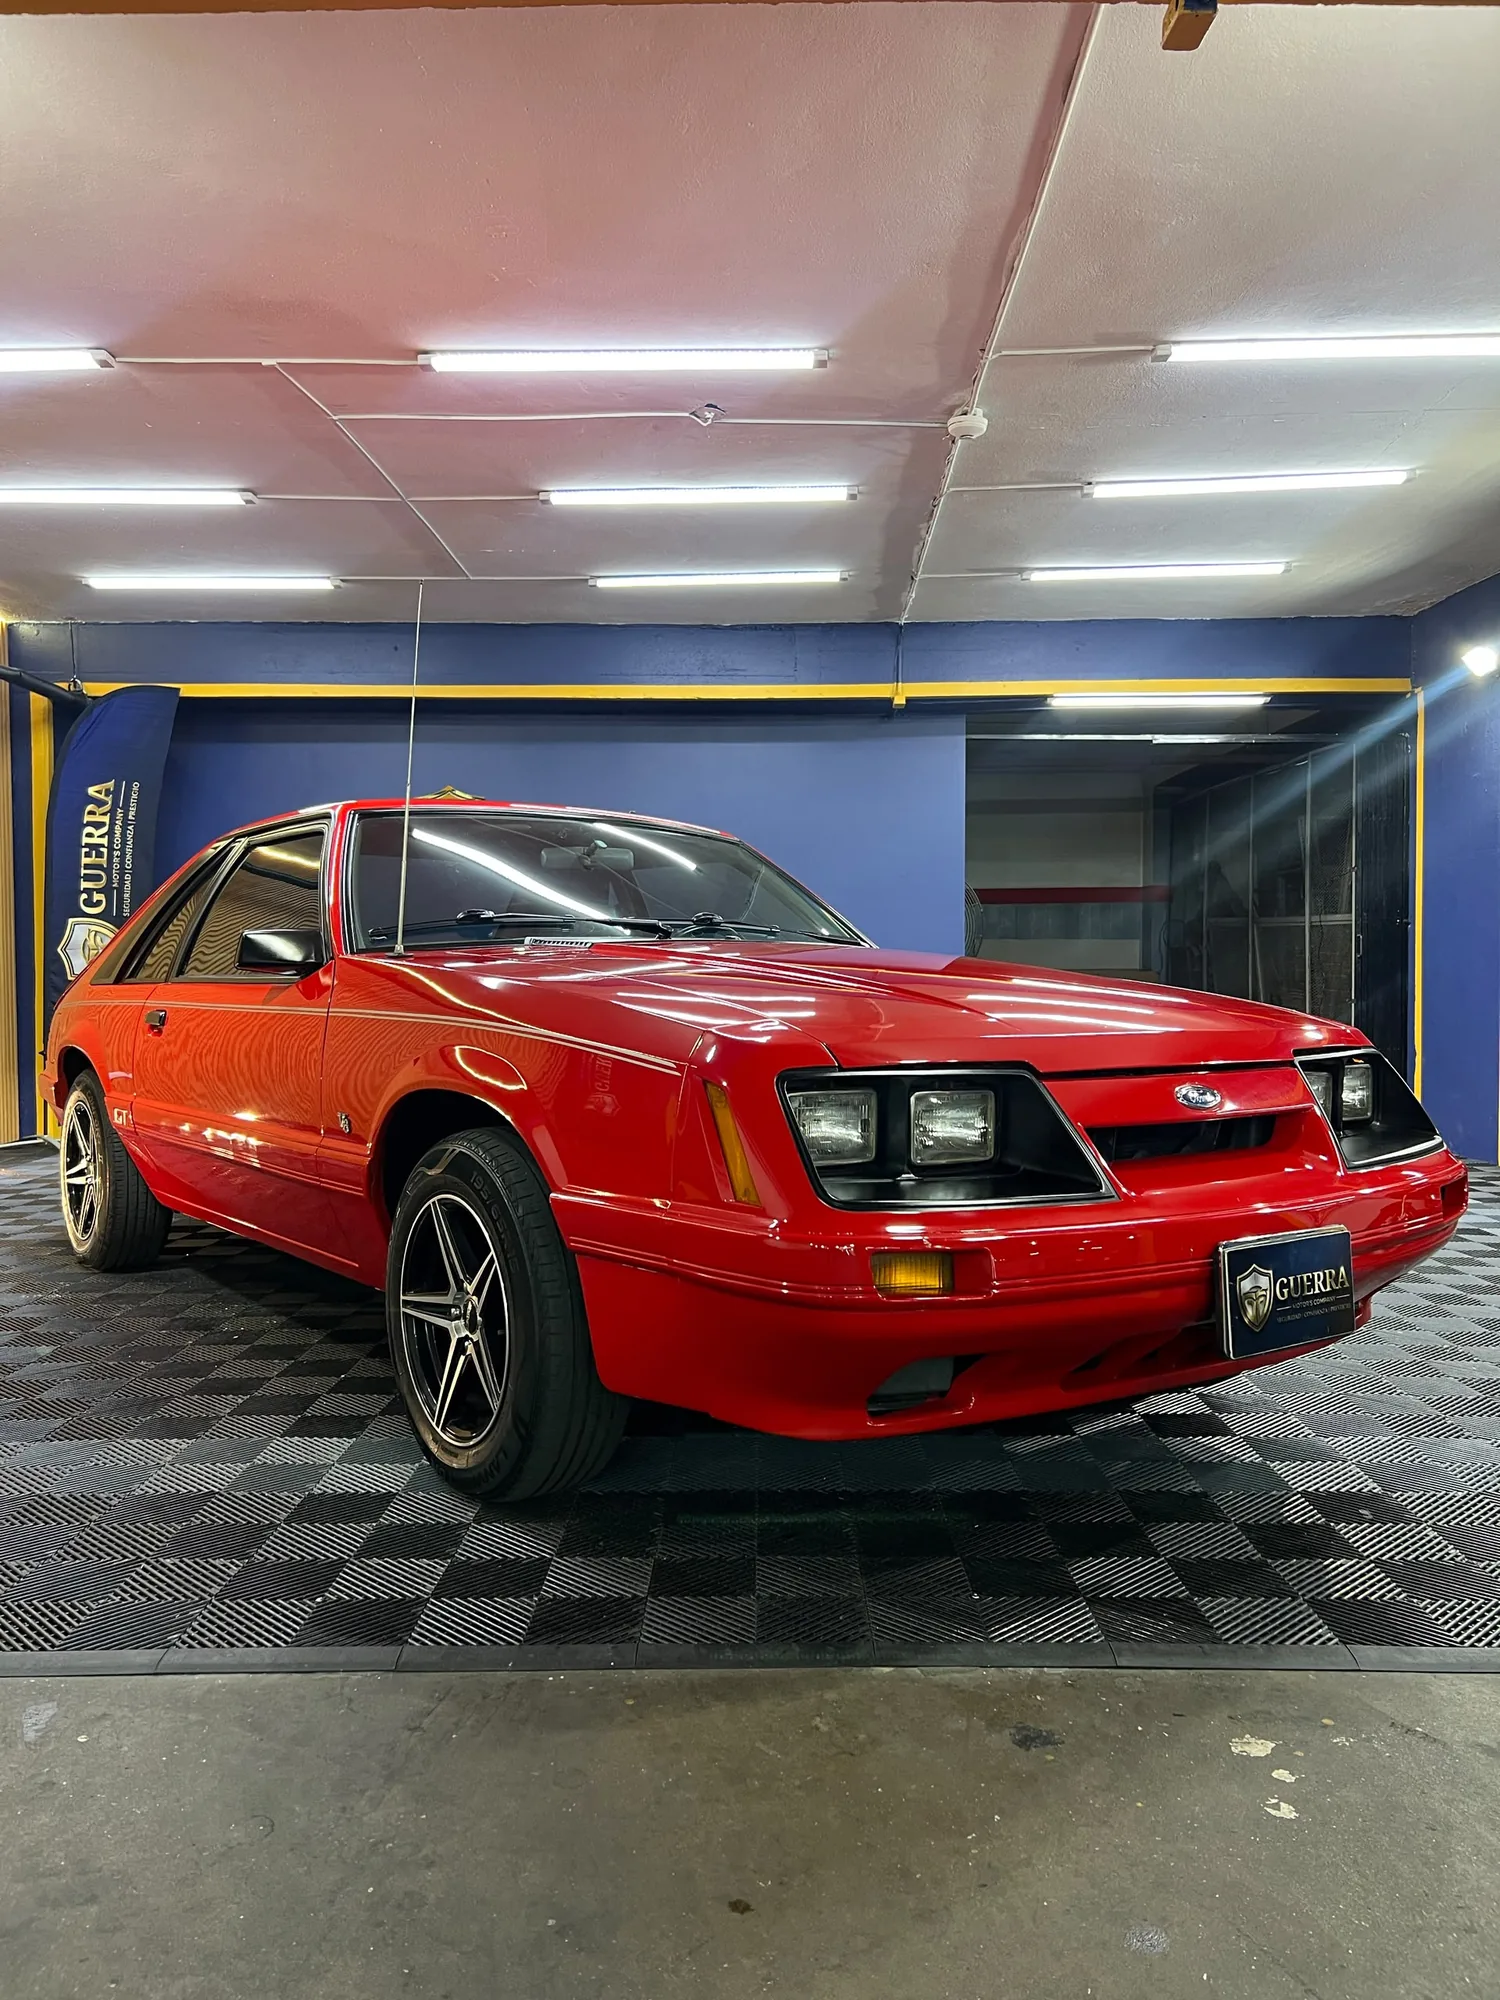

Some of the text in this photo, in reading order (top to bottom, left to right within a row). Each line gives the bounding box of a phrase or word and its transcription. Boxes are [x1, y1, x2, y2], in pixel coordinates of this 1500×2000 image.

[80, 779, 115, 914] GUERRA
[112, 808, 124, 888] MOTOR'S COMPANY
[122, 781, 140, 917] SEGURIDAD CONFIANZA PRESTIGIO
[113, 1108, 128, 1126] GT
[1276, 1265, 1349, 1300] GUERRA
